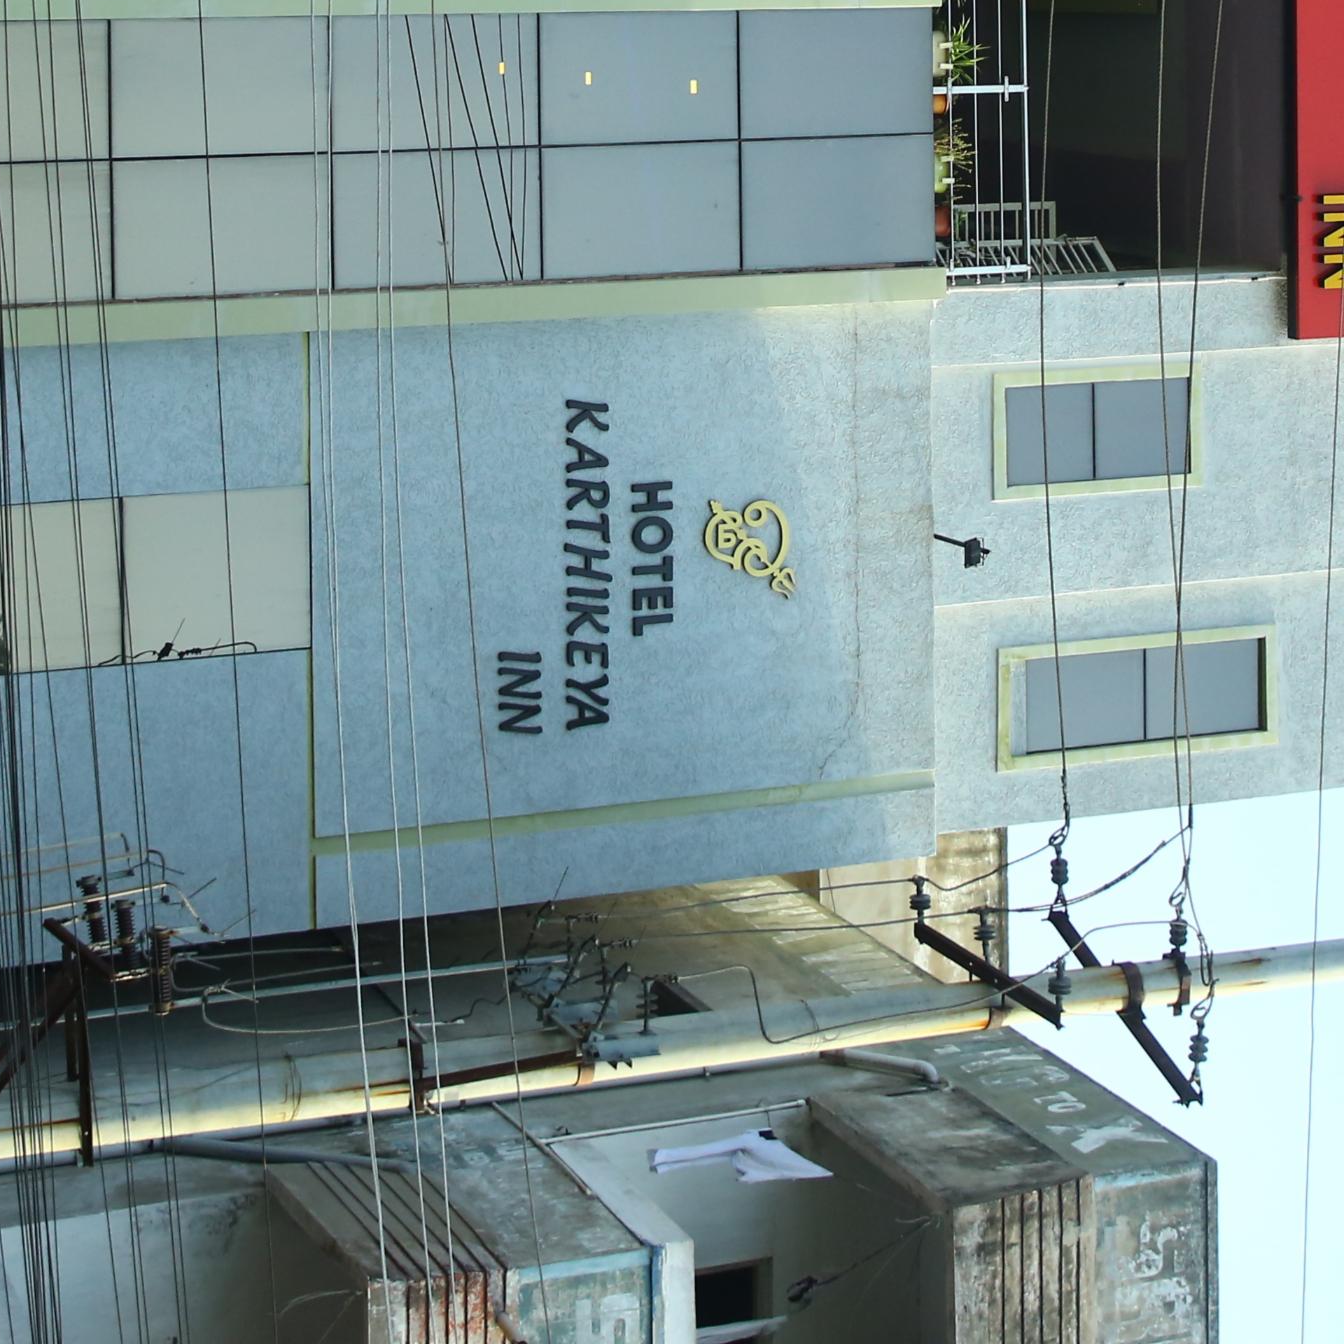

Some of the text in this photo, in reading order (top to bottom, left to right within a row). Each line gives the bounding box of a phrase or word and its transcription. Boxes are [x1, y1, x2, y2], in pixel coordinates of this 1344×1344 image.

[564, 399, 613, 731] KARTHIKEYA
[631, 481, 674, 637] HOTEL
[498, 651, 543, 735] INN
